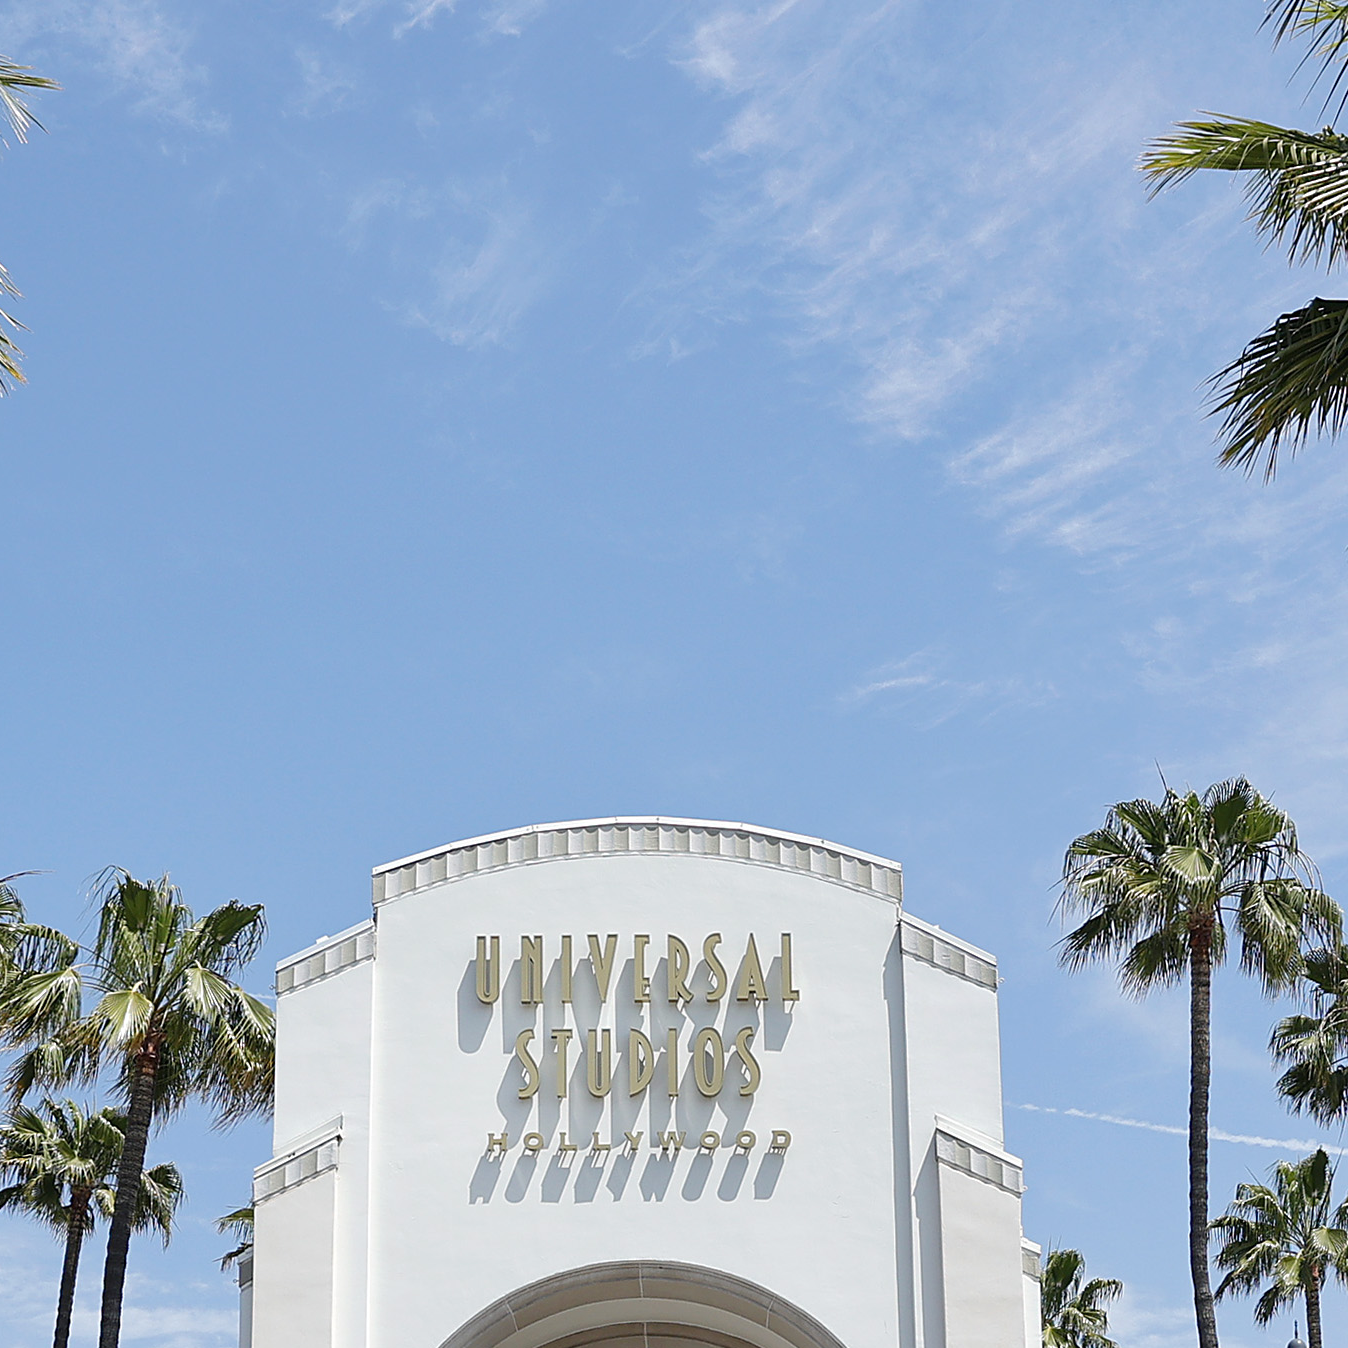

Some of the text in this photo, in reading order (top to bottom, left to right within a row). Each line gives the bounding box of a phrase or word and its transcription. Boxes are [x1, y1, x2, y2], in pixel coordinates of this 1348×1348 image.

[475, 932, 800, 1004] UNIVERSAL
[515, 1026, 761, 1099] STUDIOS
[487, 1130, 792, 1152] HOLLYWOOD
